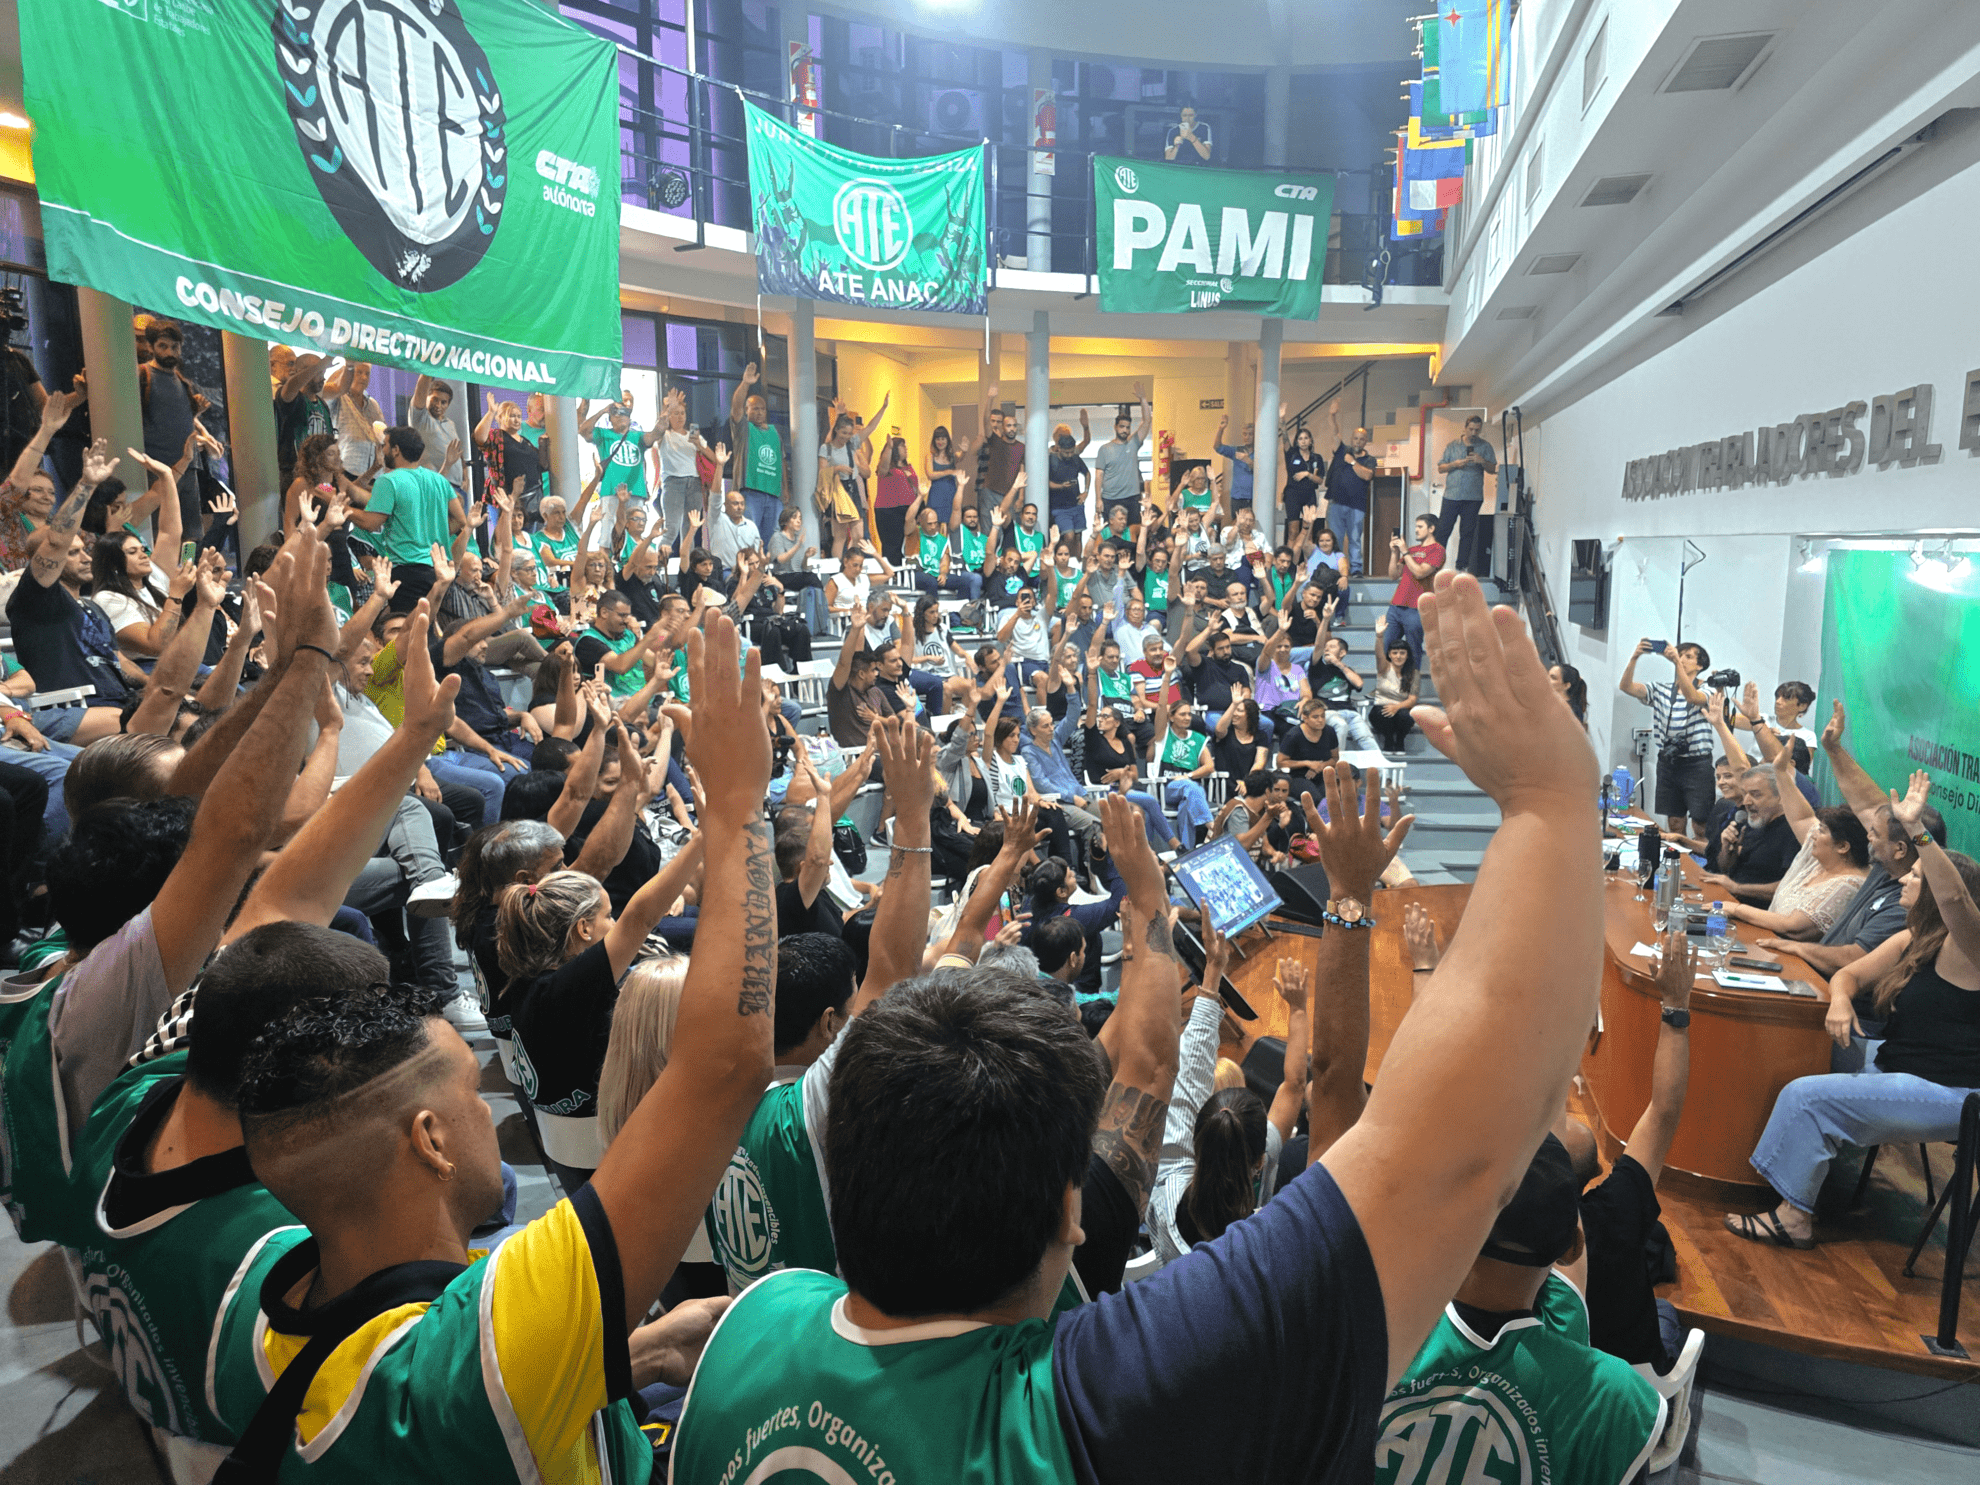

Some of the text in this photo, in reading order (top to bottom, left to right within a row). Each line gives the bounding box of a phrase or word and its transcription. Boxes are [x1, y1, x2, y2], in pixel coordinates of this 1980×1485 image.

[535, 149, 591, 194] CTA
[1274, 184, 1318, 201] CTA
[841, 184, 907, 262] ATE
[1113, 198, 1315, 281] PAMI
[818, 269, 939, 305] ATE ANAC
[176, 276, 557, 386] CONSEJO DIRECTIVO NACIONAL
[1868, 384, 1944, 471] DEL
[1930, 781, 1964, 810] onsejo
[716, 1165, 768, 1260] ATE
[745, 1405, 801, 1466] fuertes,
[1468, 1365, 1542, 1436] Organizados
